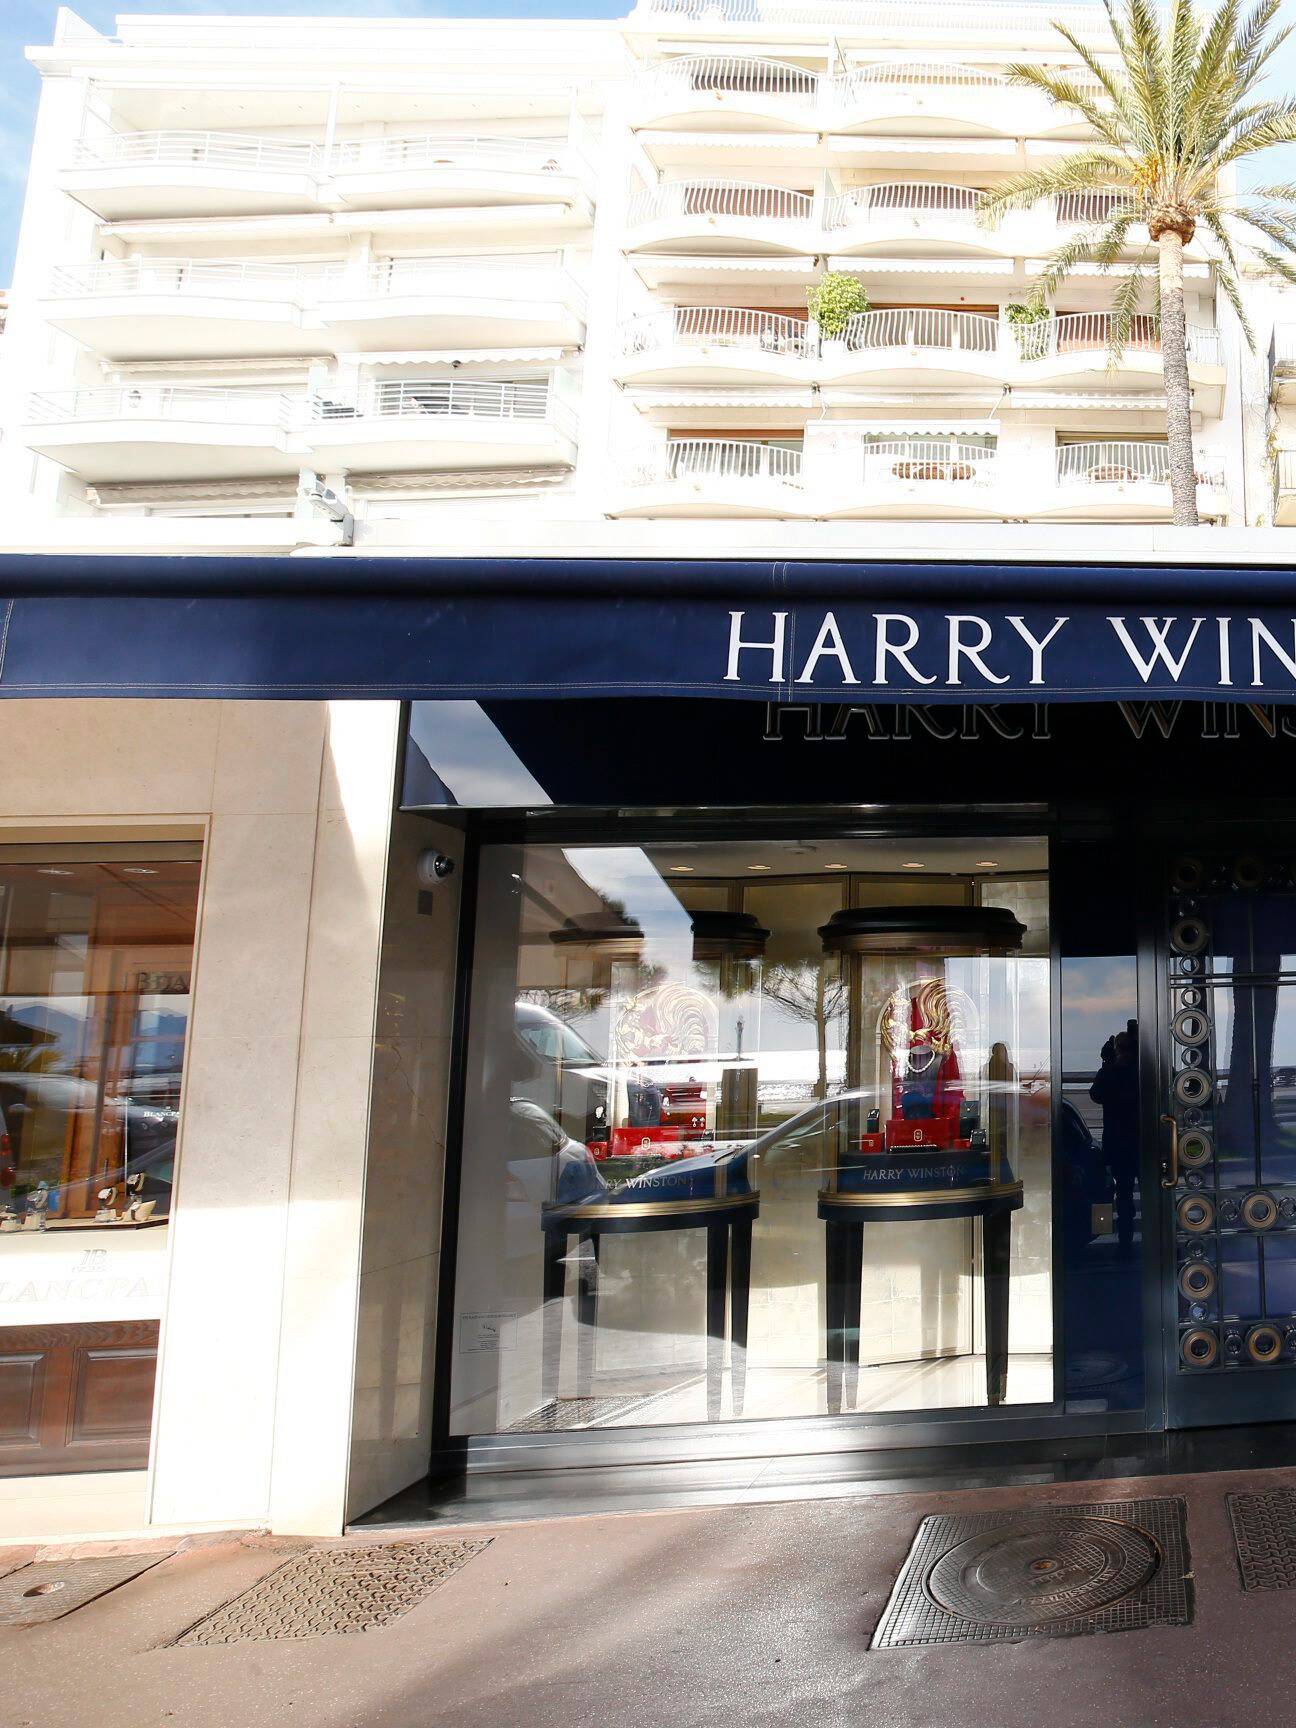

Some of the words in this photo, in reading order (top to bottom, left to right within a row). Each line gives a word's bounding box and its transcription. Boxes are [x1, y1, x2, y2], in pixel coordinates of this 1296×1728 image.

[723, 610, 1070, 686] HARRY
[863, 1168, 903, 1180] HARRY
[907, 1165, 965, 1178] WINSTON
[625, 1175, 687, 1189] WINSTON
